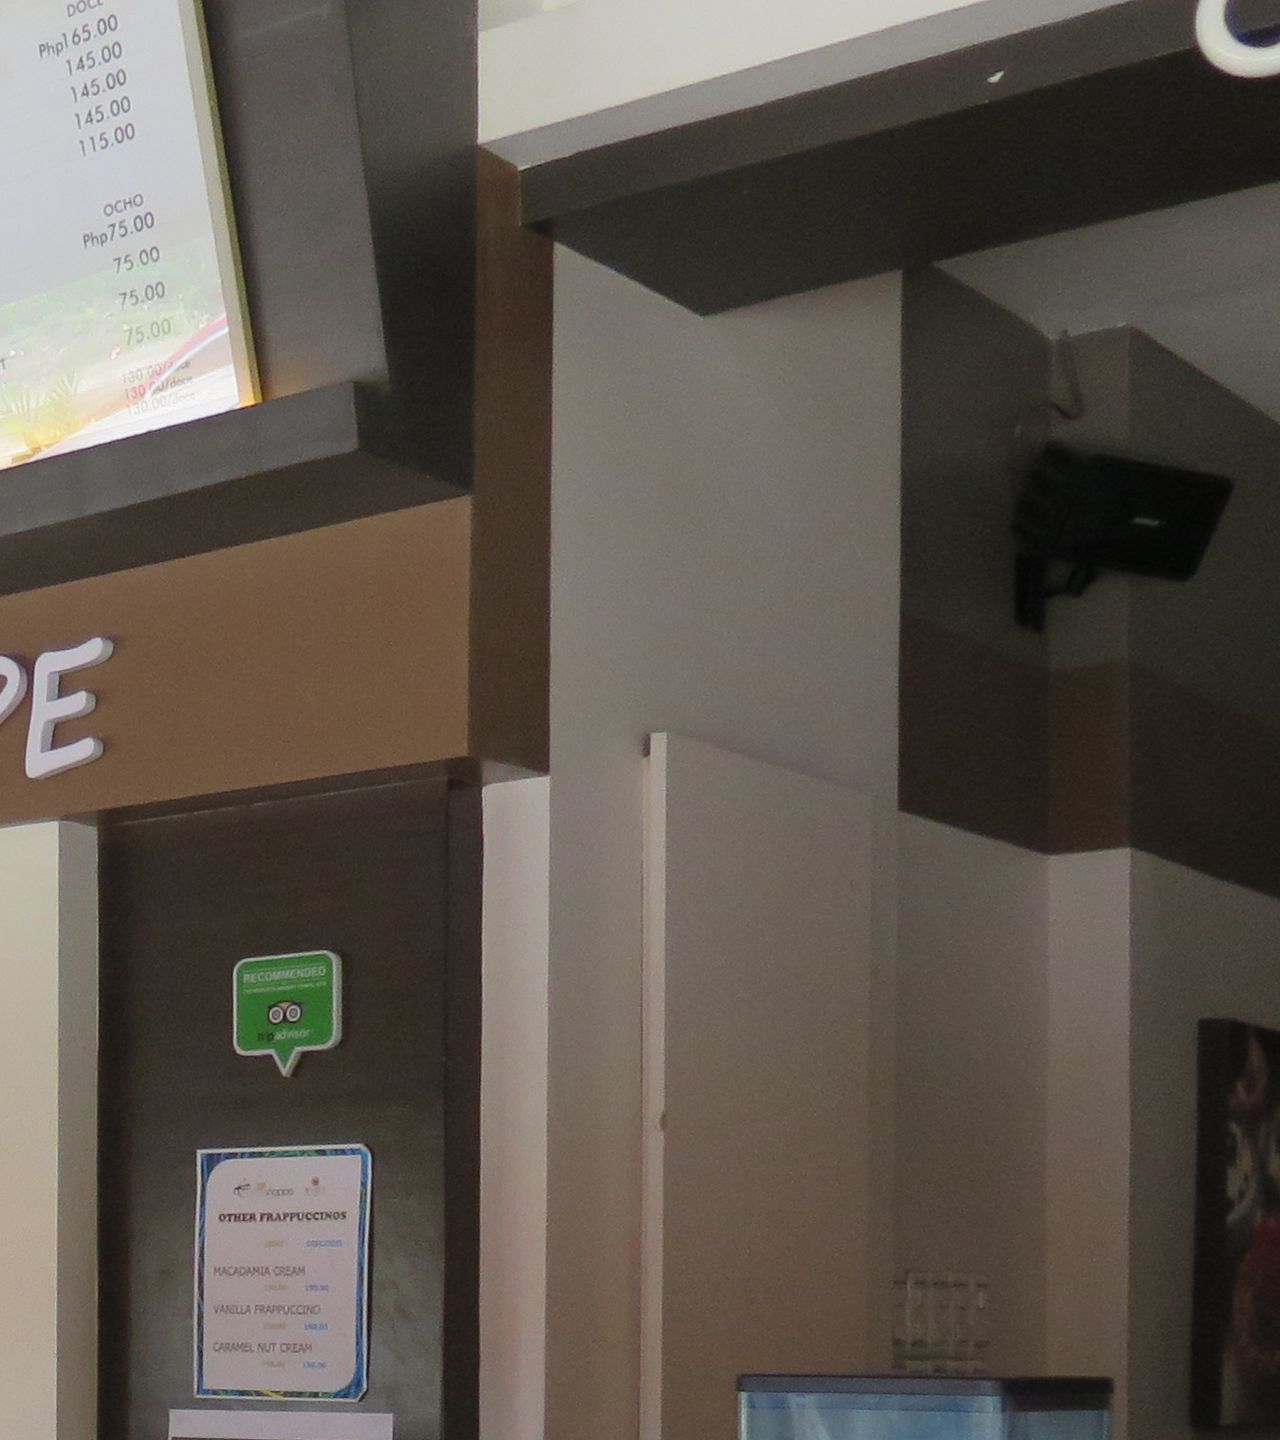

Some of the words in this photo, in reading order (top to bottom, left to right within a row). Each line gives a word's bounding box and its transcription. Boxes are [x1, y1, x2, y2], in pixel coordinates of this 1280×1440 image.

[38, 13, 118, 58] Php165.00
[65, 41, 122, 75] 145.00
[70, 68, 126, 102] 145.00
[79, 122, 135, 156] 115.00
[103, 193, 144, 217] OCHO
[82, 211, 154, 248] Php75.00
[112, 245, 160, 273] 75.00
[118, 280, 165, 308] 75.00
[218, 1213, 256, 1223] OTHER
[259, 1211, 347, 1222] FRAPPUCCINOS
